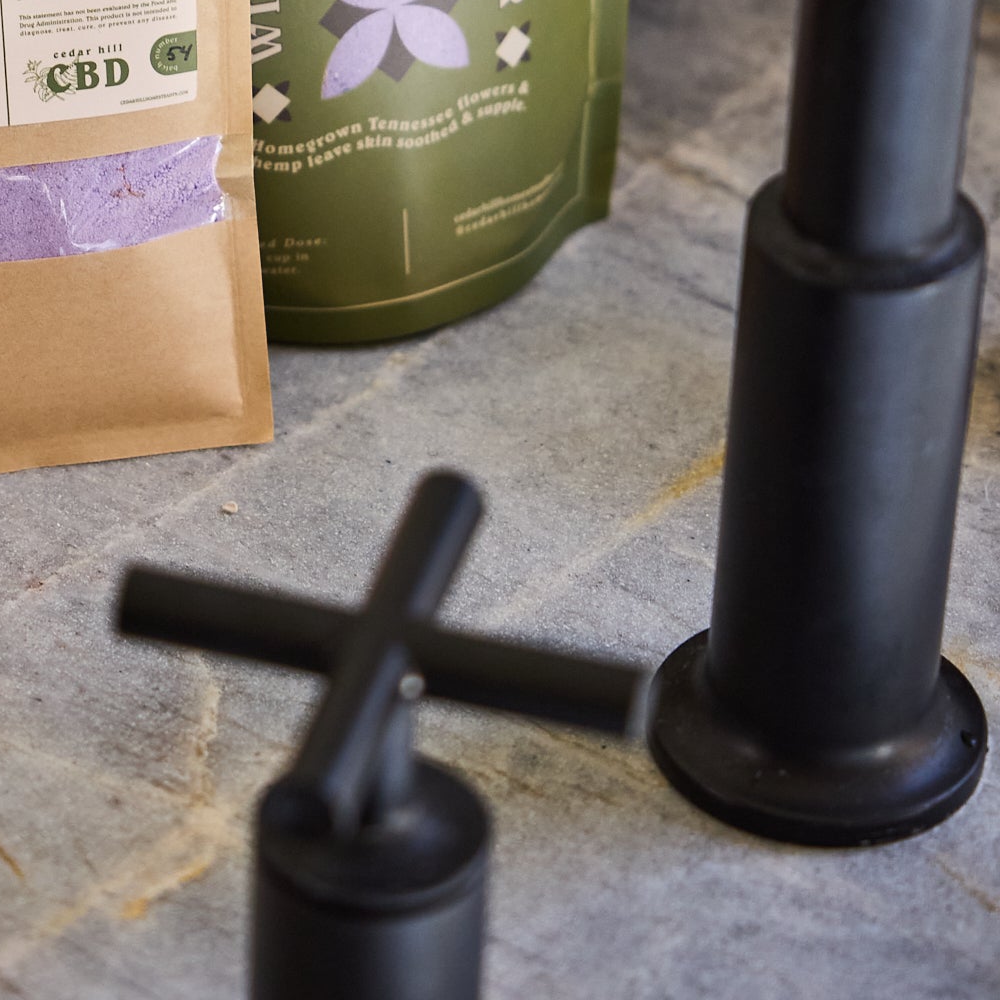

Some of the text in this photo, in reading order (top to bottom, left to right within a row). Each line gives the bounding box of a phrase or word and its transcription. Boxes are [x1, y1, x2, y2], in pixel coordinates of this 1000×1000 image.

[53, 43, 123, 58] cedar hill
[155, 37, 178, 59] number
[166, 44, 193, 61] 54
[47, 58, 130, 93] CBD
[253, 80, 529, 155] Homegrown Tennessee flowers &
[253, 156, 302, 174] hemp
[307, 141, 351, 167] leave
[356, 135, 392, 150] skin
[396, 121, 459, 149] soothed
[462, 110, 474, 125] &
